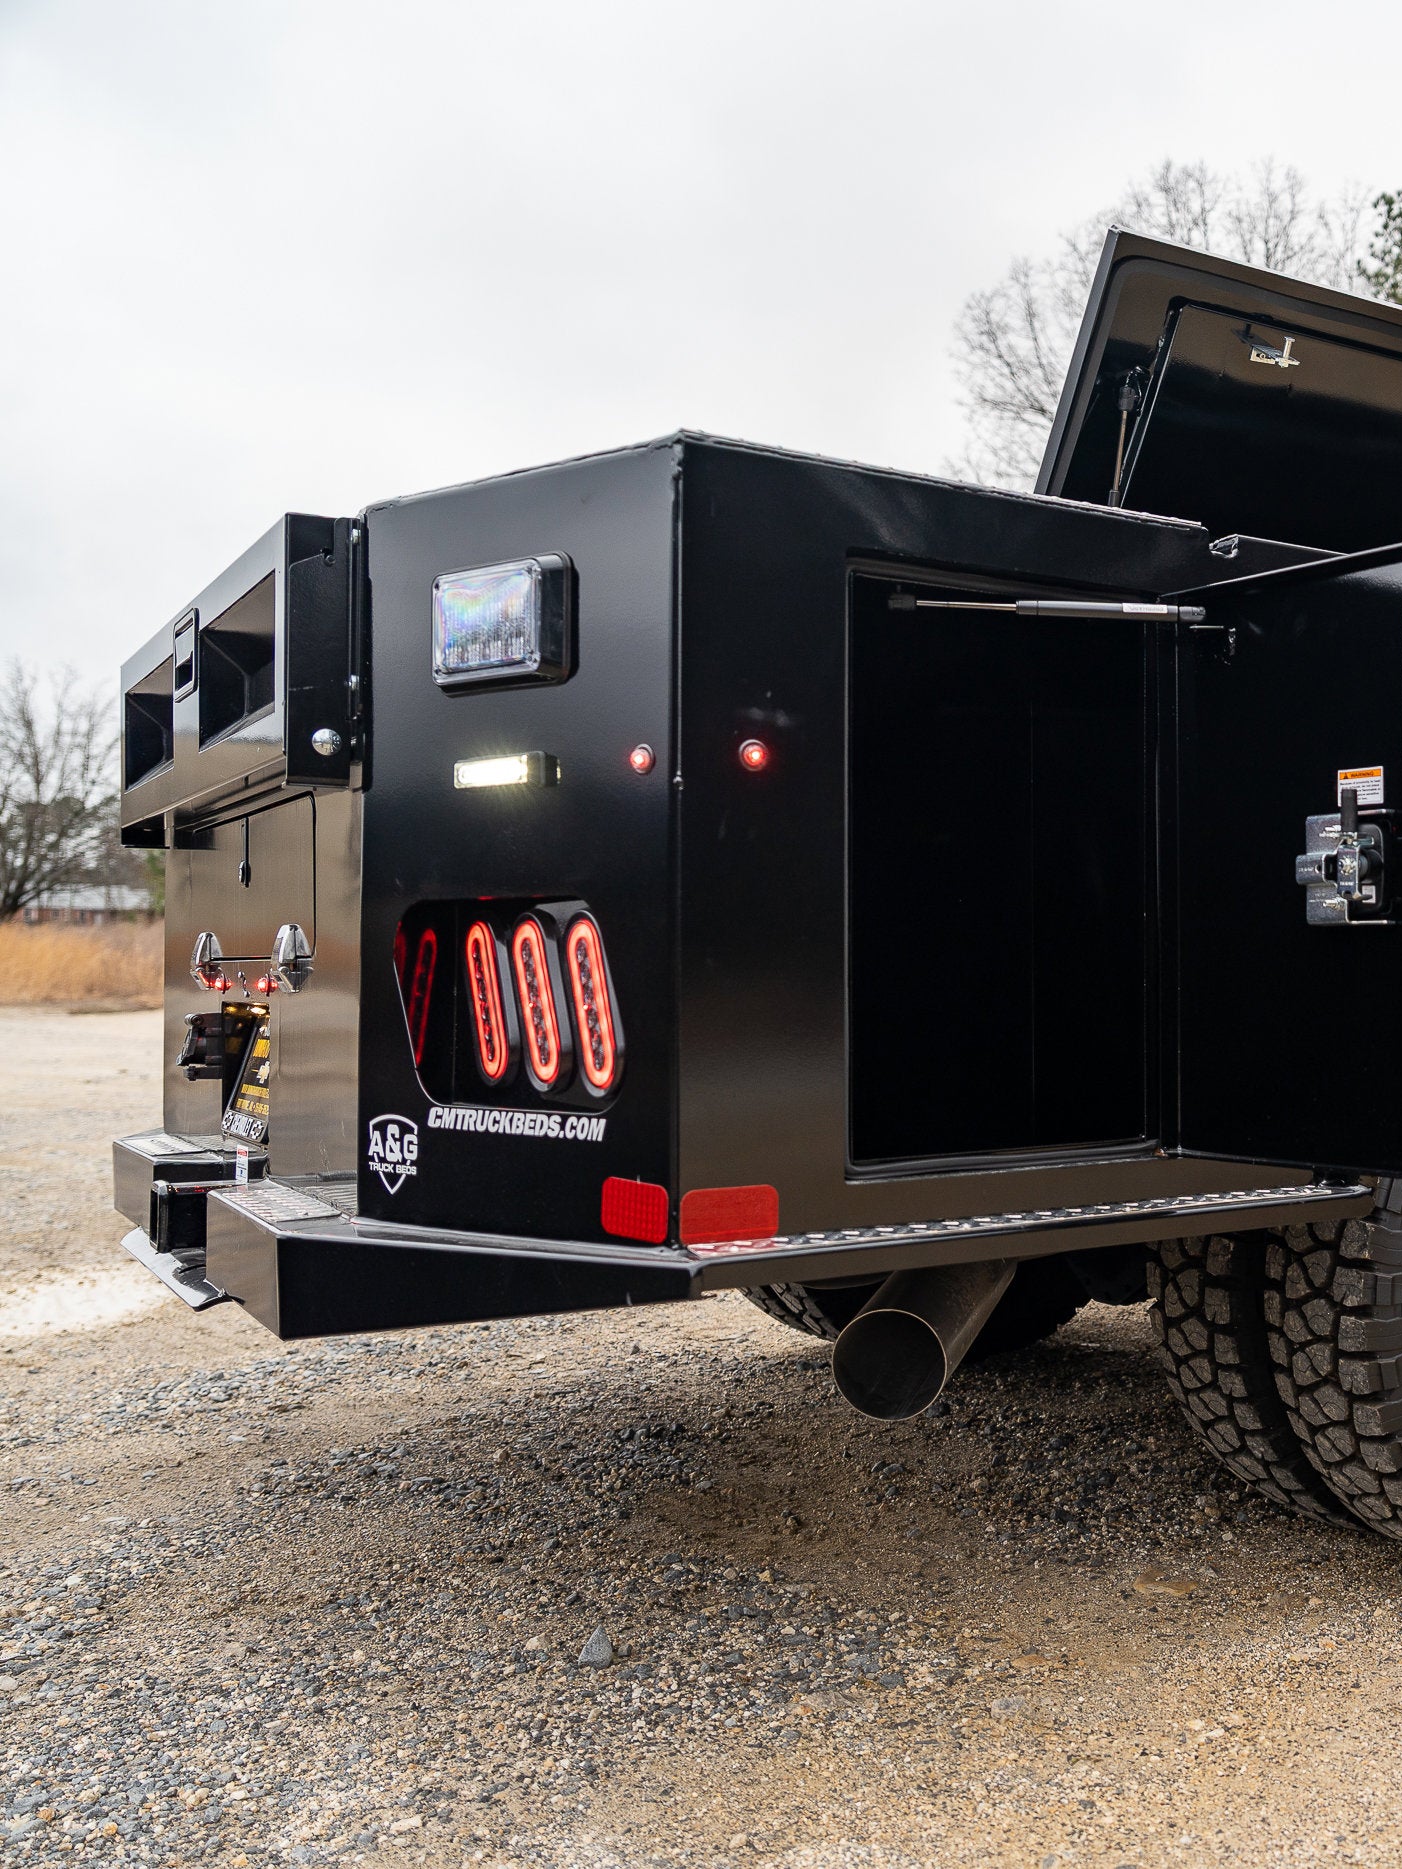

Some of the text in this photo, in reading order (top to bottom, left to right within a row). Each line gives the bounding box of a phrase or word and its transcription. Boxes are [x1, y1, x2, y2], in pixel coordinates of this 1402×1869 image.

[427, 1106, 607, 1142] CMTRUCKBEDS.COM
[368, 1123, 418, 1163] A&G
[368, 1161, 417, 1176] TRUCK BEDS
